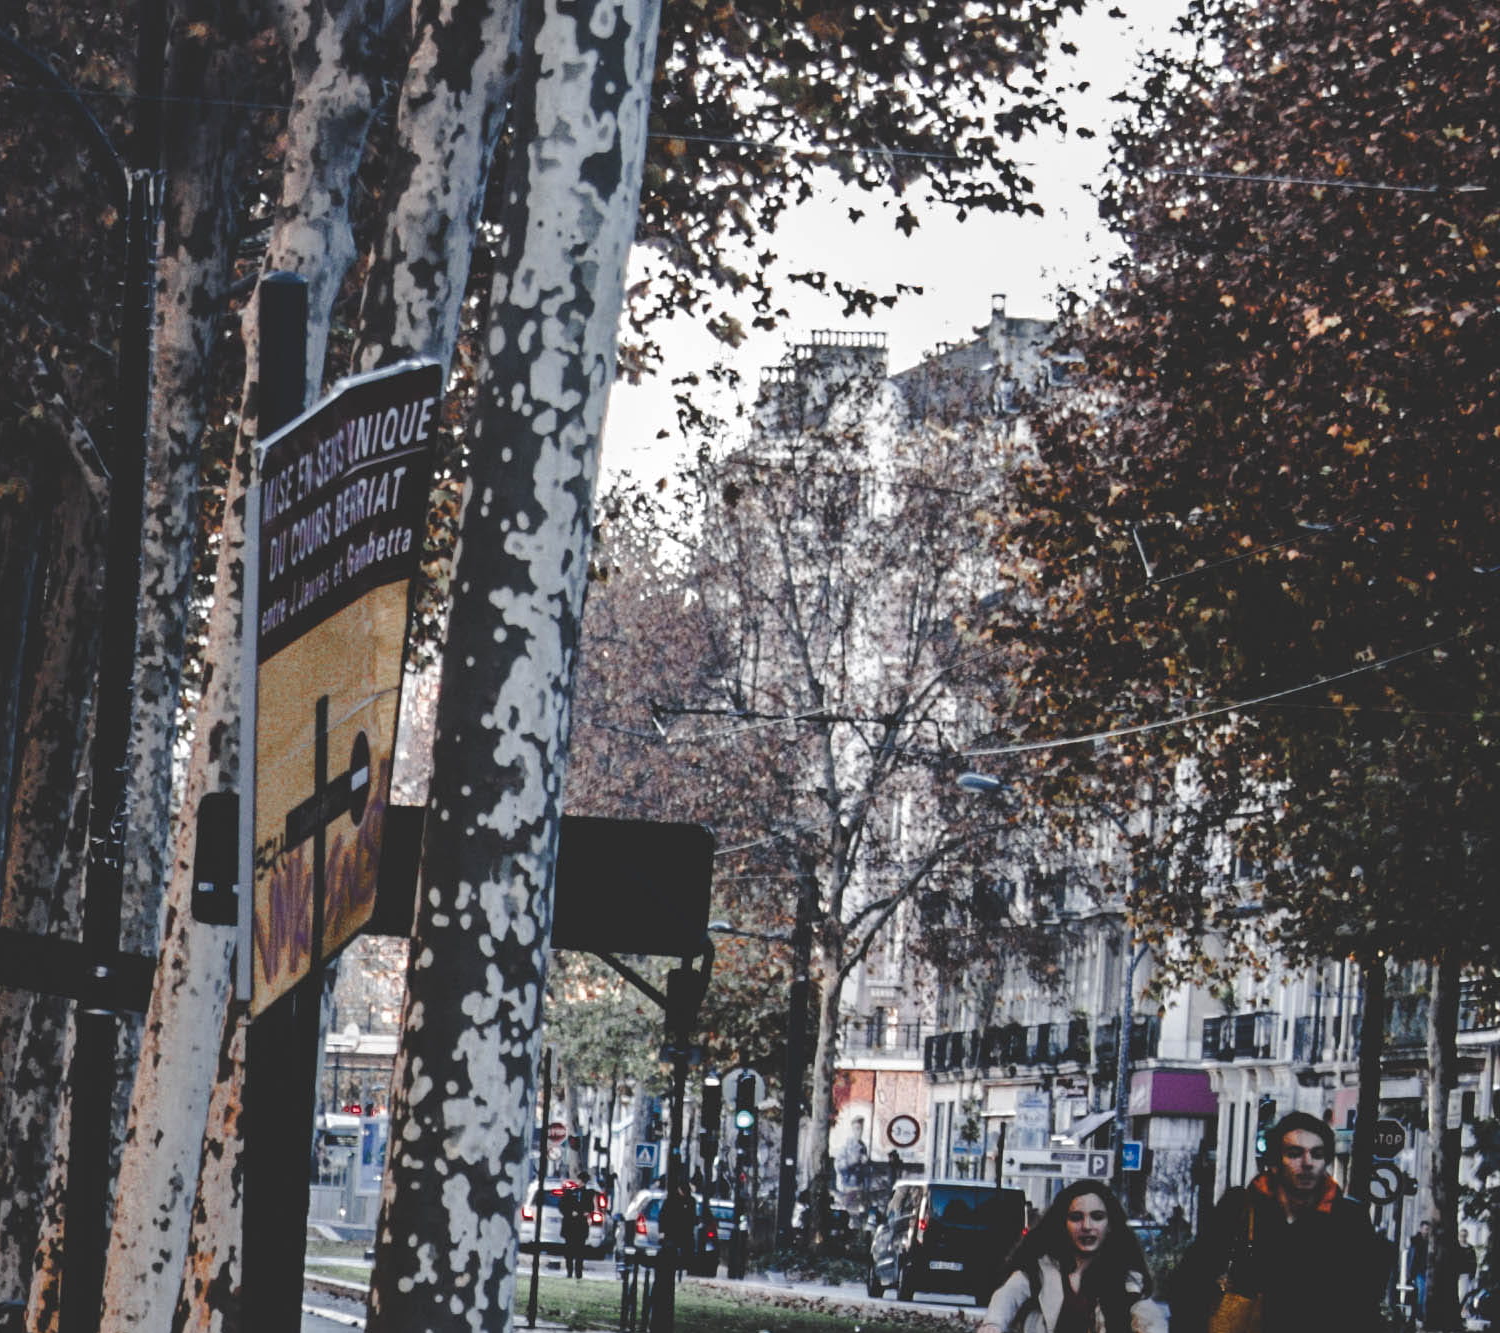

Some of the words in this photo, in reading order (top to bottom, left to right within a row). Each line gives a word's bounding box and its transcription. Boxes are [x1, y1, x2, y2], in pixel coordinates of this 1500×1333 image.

[263, 463, 294, 524] MISE
[297, 452, 314, 502] EN
[316, 428, 346, 488] SENS
[346, 397, 435, 465] UNIQUE
[269, 529, 288, 582] DU
[290, 501, 332, 567] COURS
[334, 466, 407, 537] BERRIAT
[261, 596, 287, 636] entre
[333, 555, 344, 588] et
[346, 526, 413, 579] Gambetta
[1092, 1156, 1106, 1175] P
